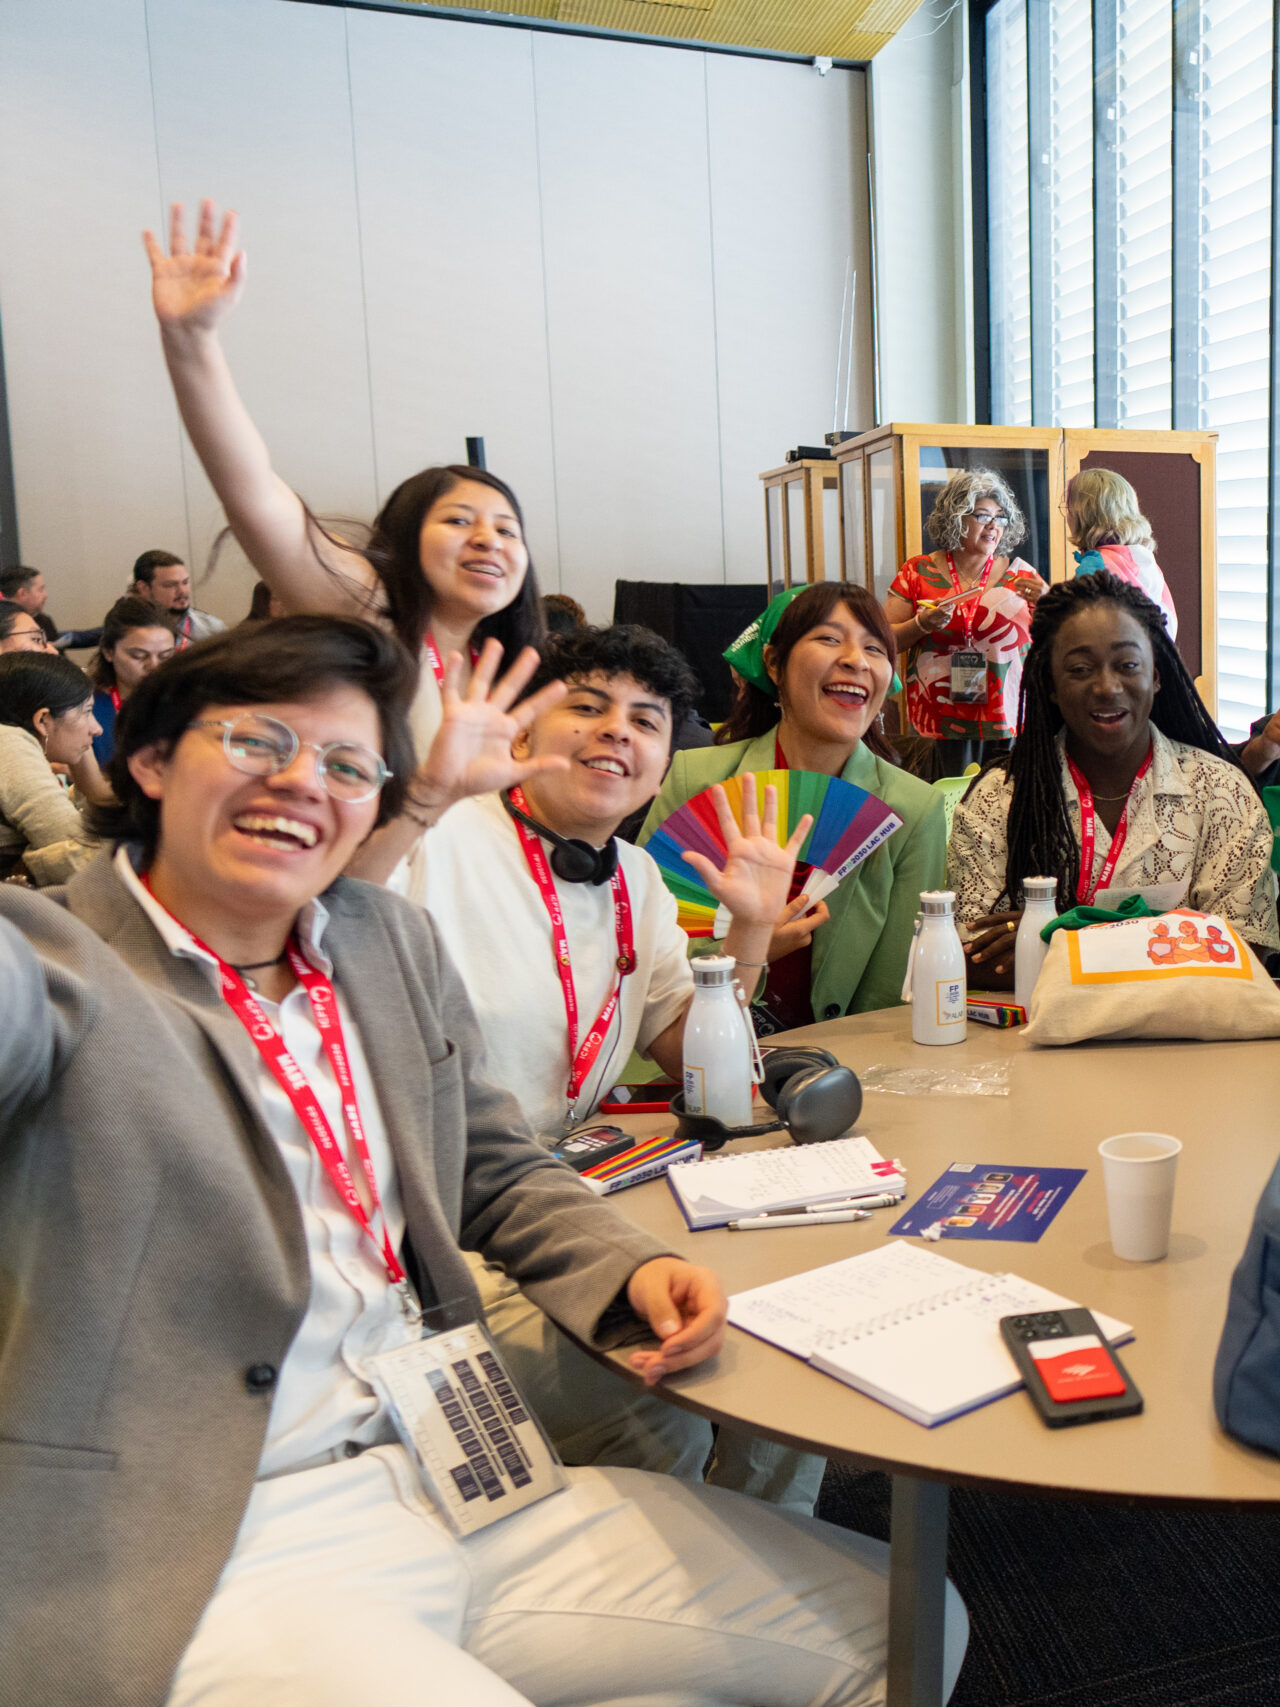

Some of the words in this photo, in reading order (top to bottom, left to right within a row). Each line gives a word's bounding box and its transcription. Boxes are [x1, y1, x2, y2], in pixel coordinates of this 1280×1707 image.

[866, 836, 880, 849] LAC
[880, 822, 895, 837] HUB
[580, 1041, 592, 1059] ICFP
